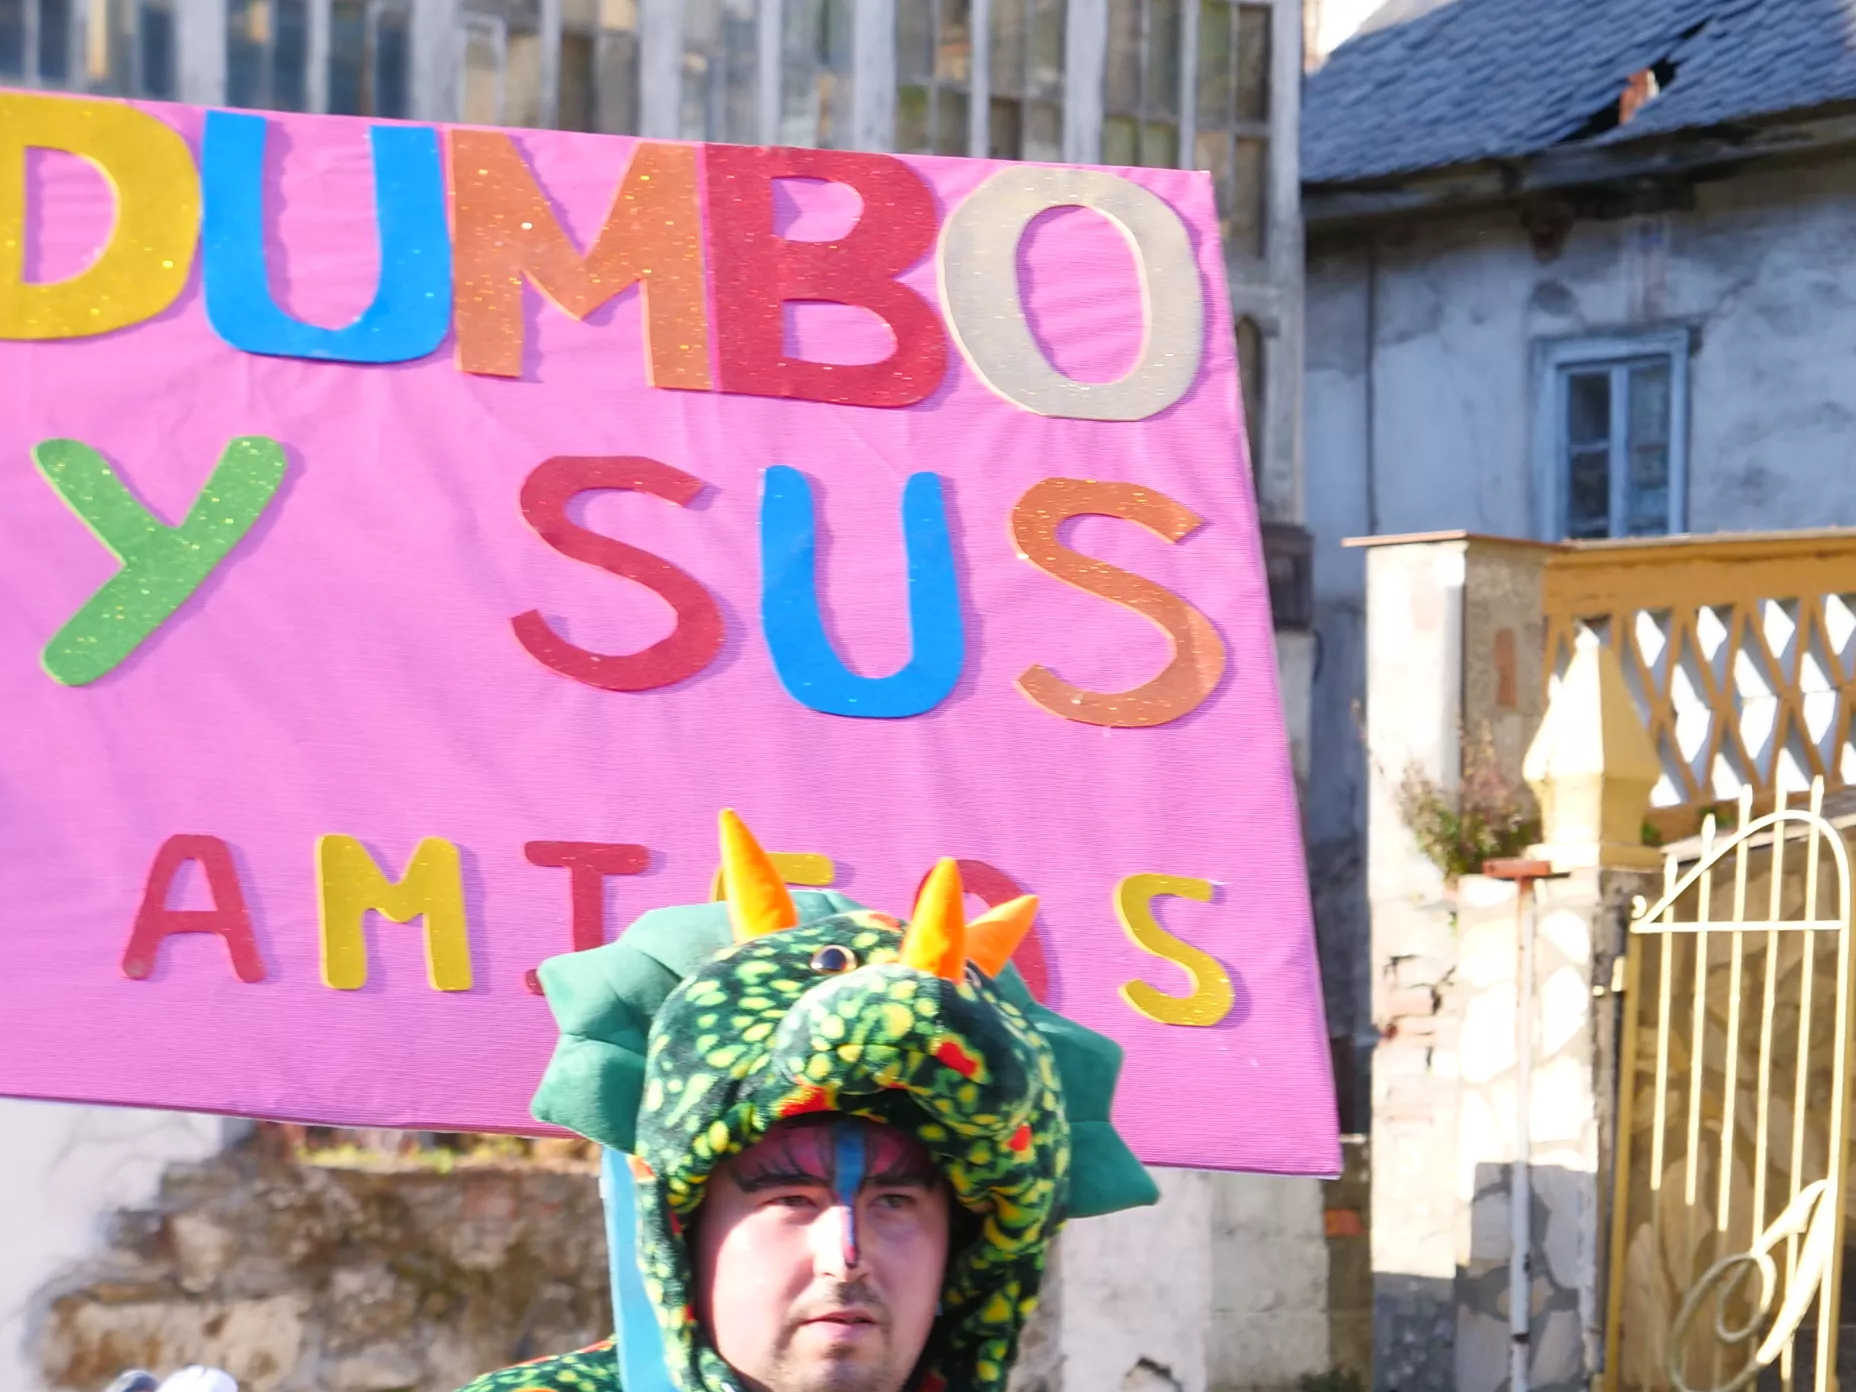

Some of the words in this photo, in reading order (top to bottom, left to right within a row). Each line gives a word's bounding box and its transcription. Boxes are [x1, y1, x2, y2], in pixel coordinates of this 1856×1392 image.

[30, 434, 288, 688] Y
[510, 455, 1227, 728] SUS
[119, 832, 1235, 1027] AMIS
